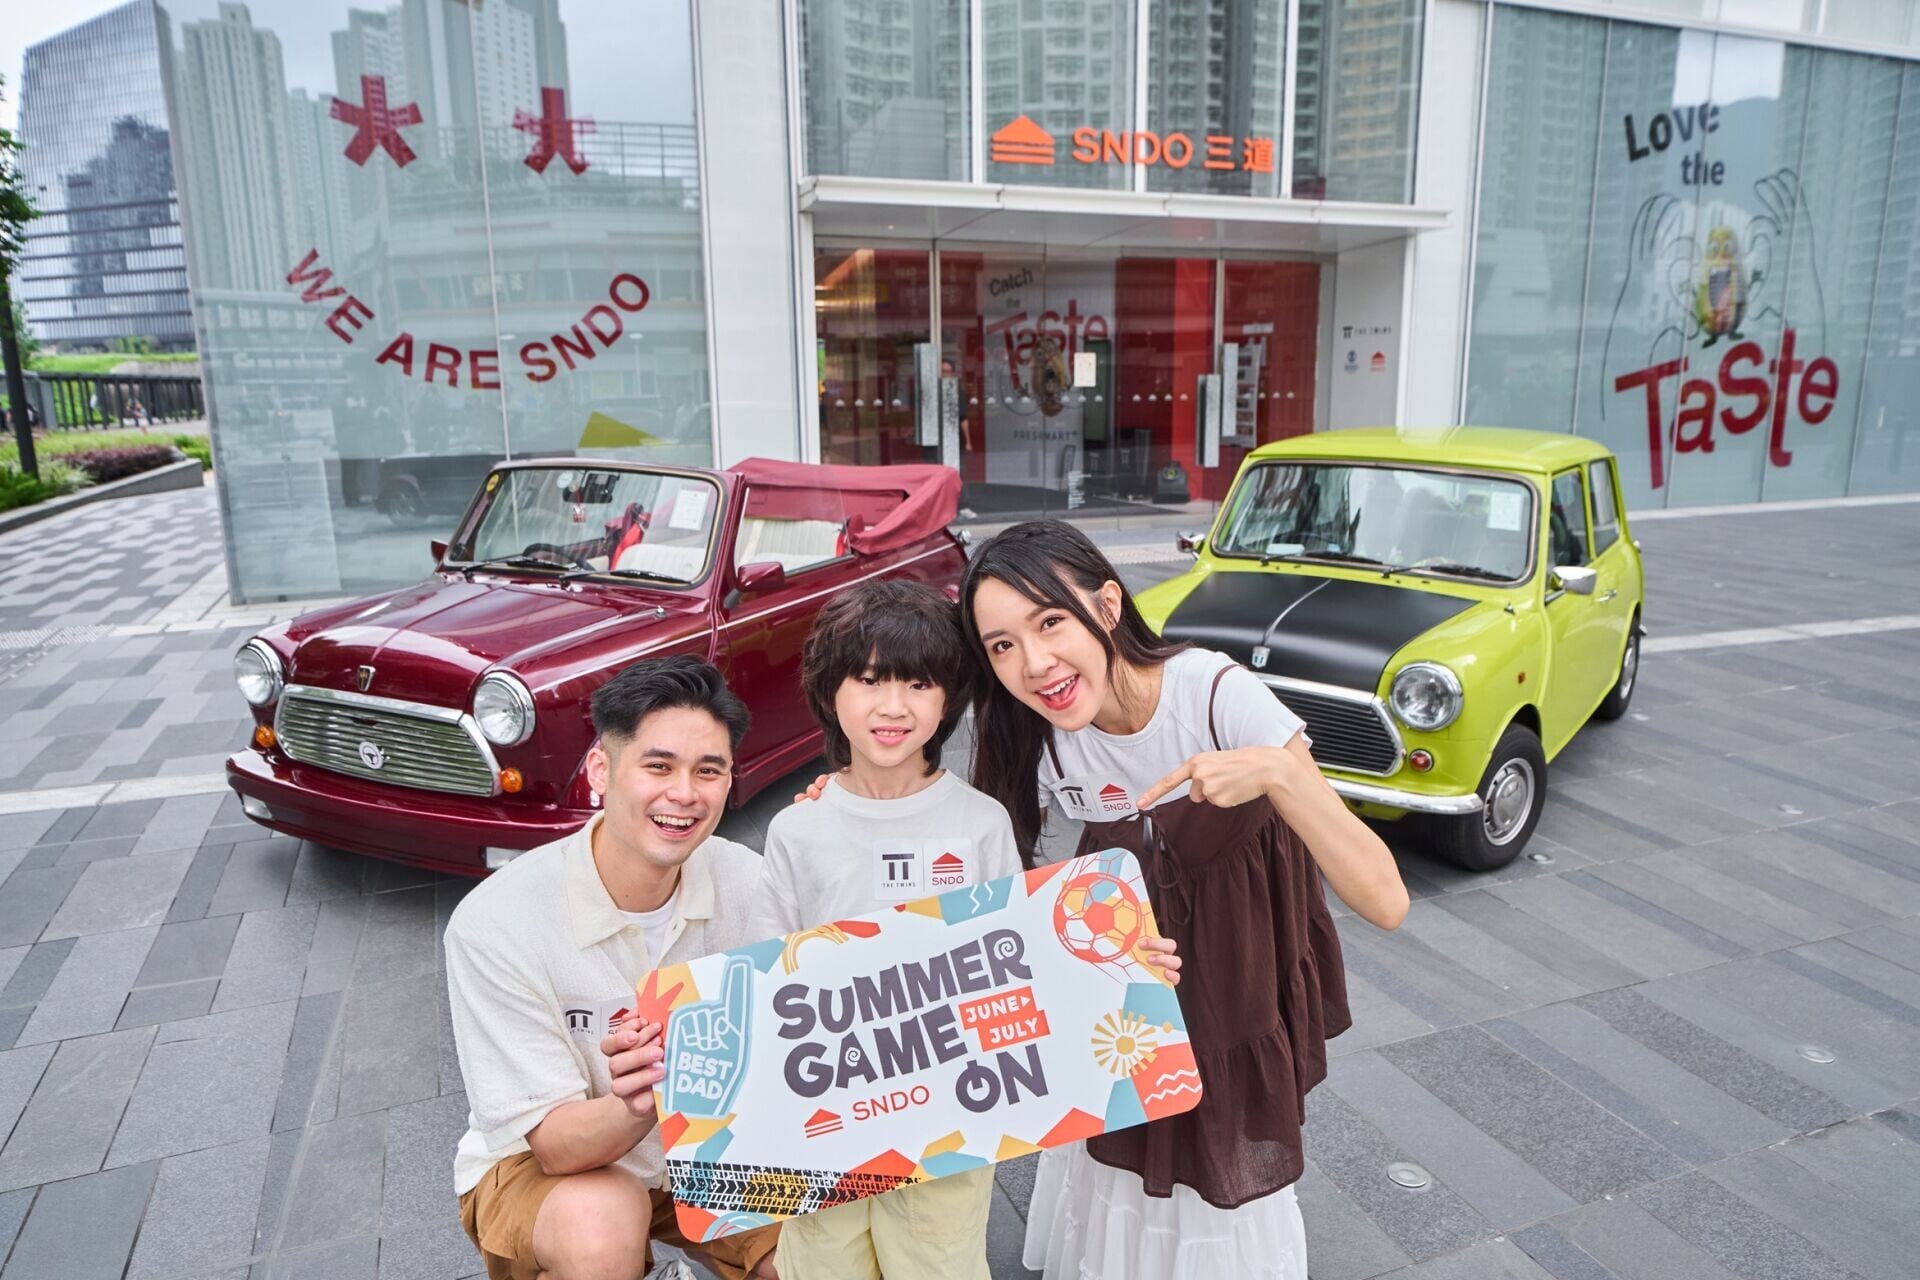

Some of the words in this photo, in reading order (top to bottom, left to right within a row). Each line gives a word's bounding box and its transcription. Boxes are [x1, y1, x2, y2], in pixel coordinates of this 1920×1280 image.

[1071, 127, 1194, 169] SNDO
[1624, 102, 1721, 162] Love
[1203, 135, 1275, 173] 三道
[1681, 152, 1726, 187] the
[989, 267, 1033, 296] Catch
[286, 247, 375, 345] WE
[375, 331, 501, 391] ARE
[519, 272, 651, 383] SNDO
[1615, 328, 1840, 490] Taste
[1103, 802, 1132, 812] SNDO
[932, 875, 964, 886] SNDO
[773, 929, 1033, 1040] SUMMER
[965, 996, 1019, 1024] JUNE
[989, 1017, 1038, 1044] JULY
[677, 1051, 734, 1080] BEST
[784, 1003, 968, 1098] GAME
[675, 1073, 723, 1100] DAD
[955, 1043, 1049, 1113] ON
[852, 1085, 930, 1121] SNDO
